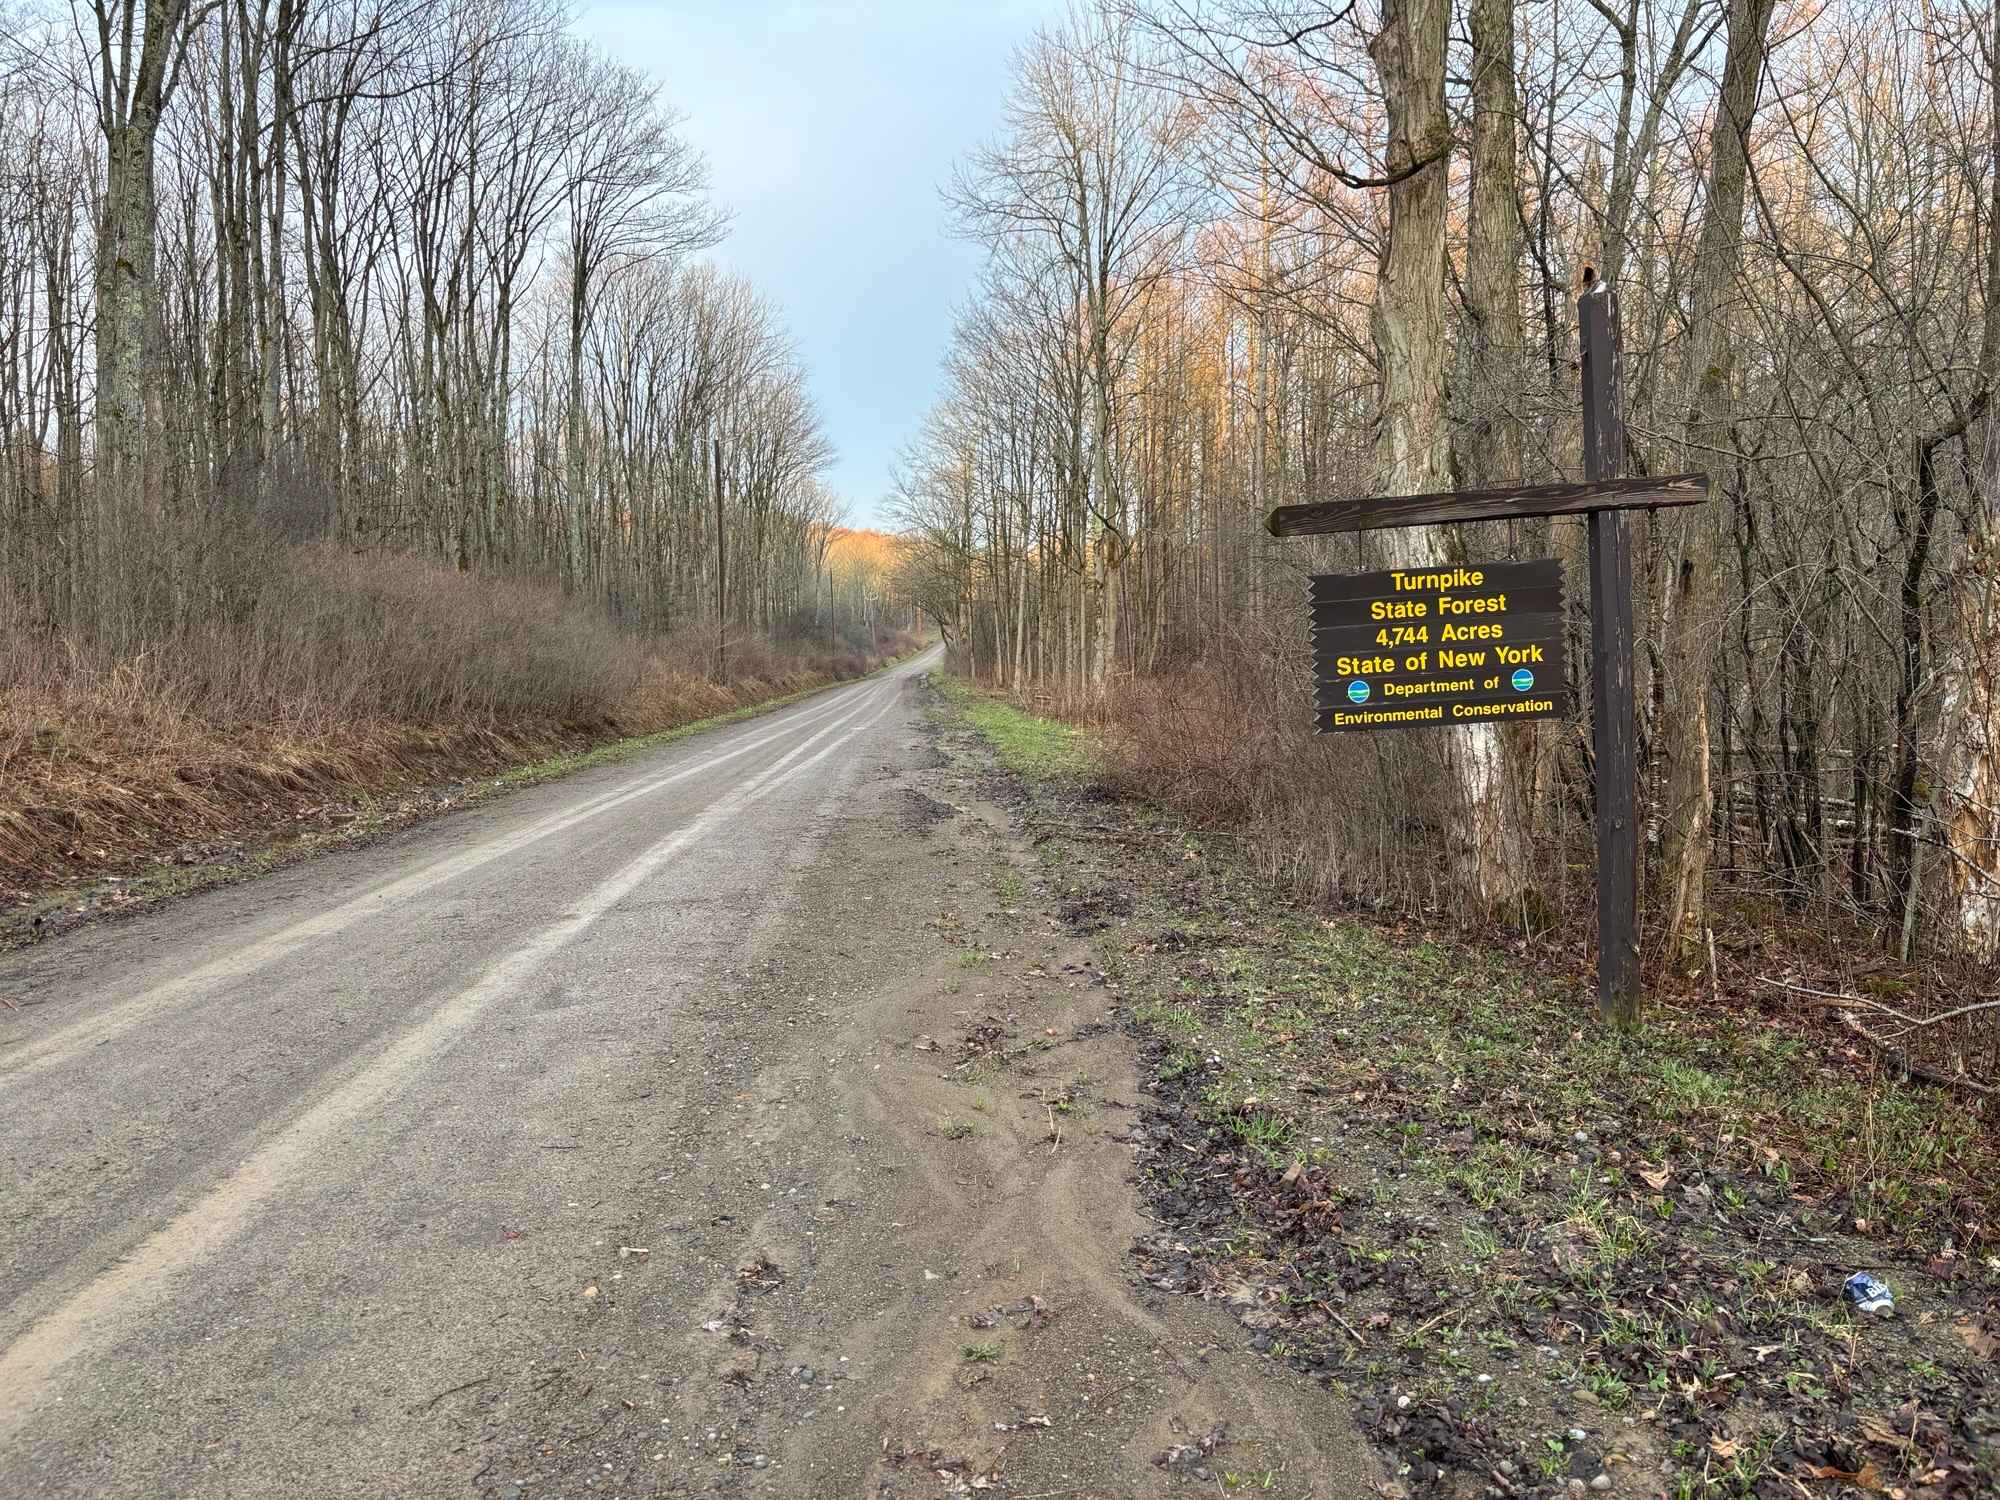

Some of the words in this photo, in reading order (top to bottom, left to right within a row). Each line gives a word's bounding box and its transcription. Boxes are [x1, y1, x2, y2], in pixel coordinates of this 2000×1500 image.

[1392, 569, 1484, 592] Turnpike
[1371, 601, 1427, 620] State
[1439, 594, 1506, 615] Forest
[1376, 626, 1429, 648] 4,744
[1441, 623, 1503, 642] Acres
[1336, 657, 1395, 676] State
[1405, 652, 1428, 671] of
[1439, 650, 1486, 668] New
[1495, 645, 1543, 665] York
[1384, 678, 1475, 697] Department
[1484, 676, 1500, 689] of
[1335, 707, 1443, 726] Environmental
[1453, 699, 1553, 717] Conservation
